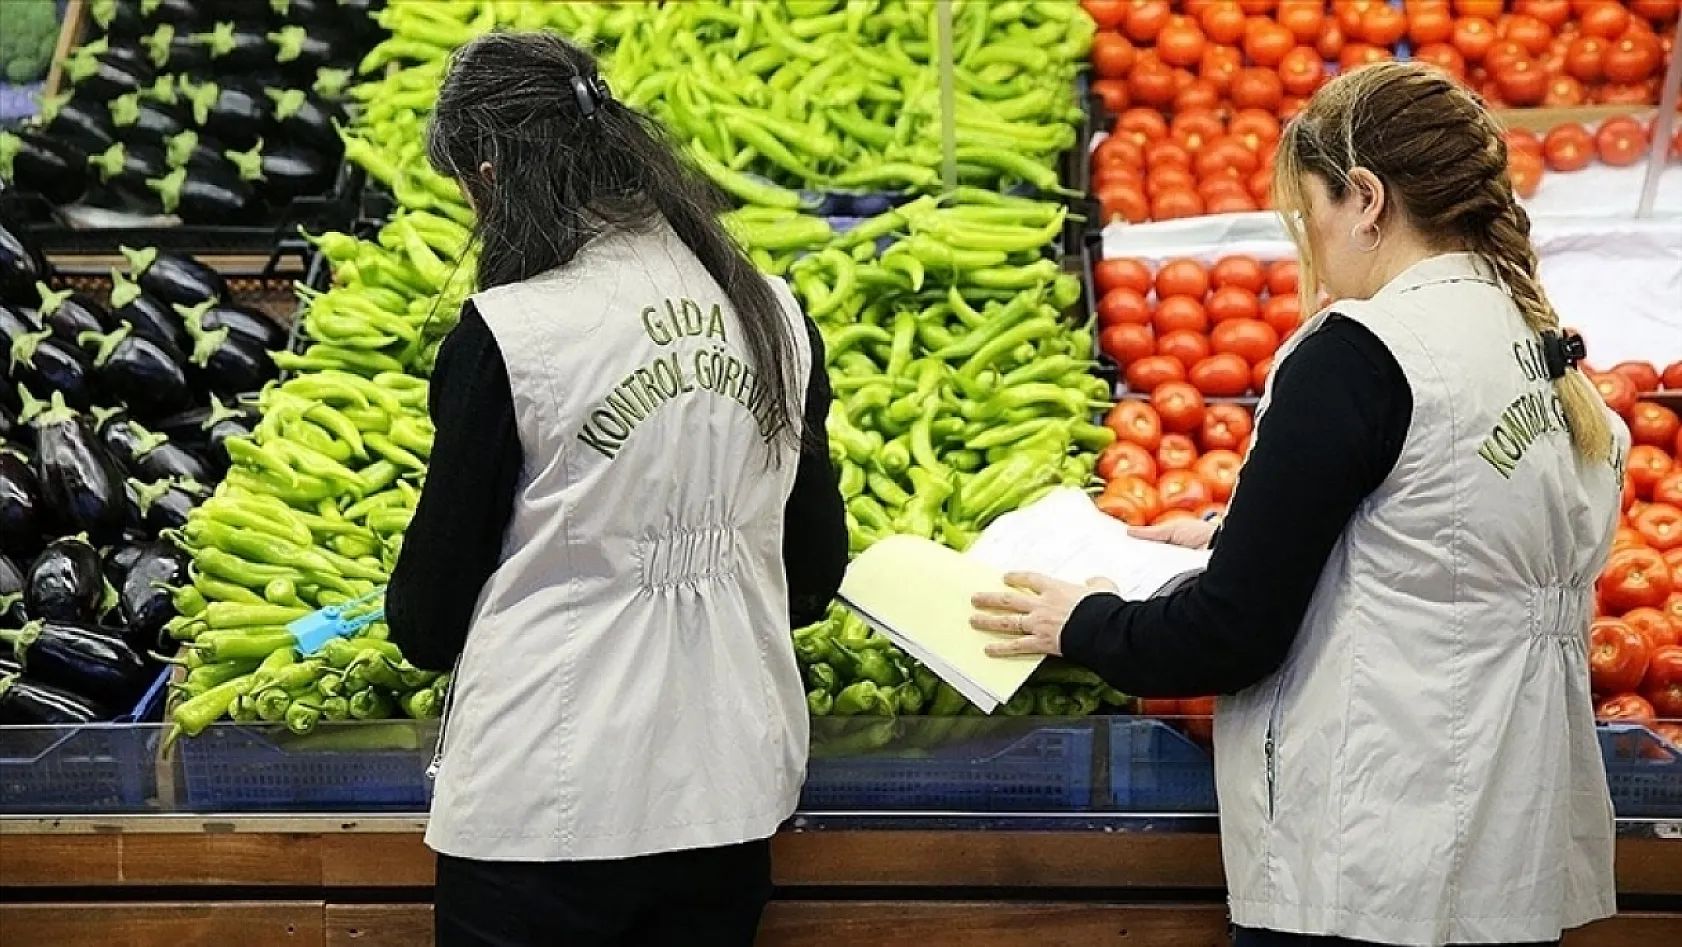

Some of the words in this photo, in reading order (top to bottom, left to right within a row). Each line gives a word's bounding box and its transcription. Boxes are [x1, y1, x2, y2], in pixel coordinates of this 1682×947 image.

[641, 297, 727, 346] GIDA
[577, 351, 695, 460] KONTROL
[1477, 389, 1557, 480] KONTROL
